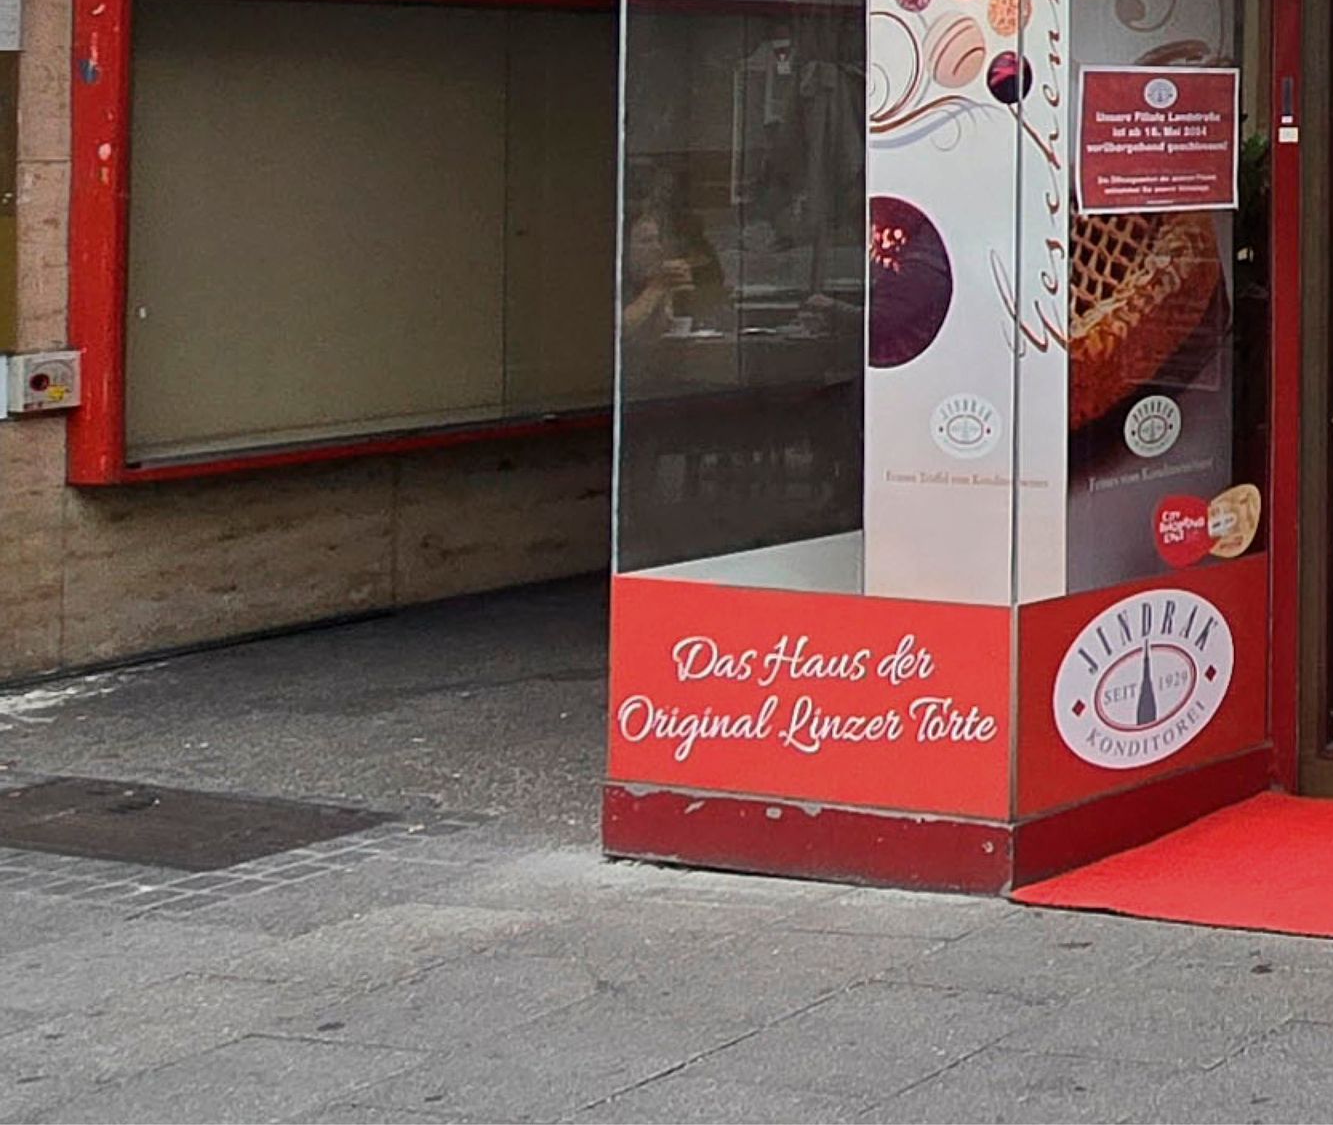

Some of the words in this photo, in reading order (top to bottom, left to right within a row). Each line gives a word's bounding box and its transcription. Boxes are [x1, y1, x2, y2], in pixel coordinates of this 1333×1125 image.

[671, 634, 757, 683] Das
[764, 633, 867, 686] Haus
[876, 633, 935, 681] der
[1077, 600, 1219, 675] JINDRAK
[1103, 683, 1138, 706] SEIT
[1157, 670, 1189, 692] 1929
[617, 694, 771, 762] Original
[778, 695, 904, 753] Linzer
[908, 696, 998, 745] Torte
[1085, 700, 1206, 758] KONDITOREI
